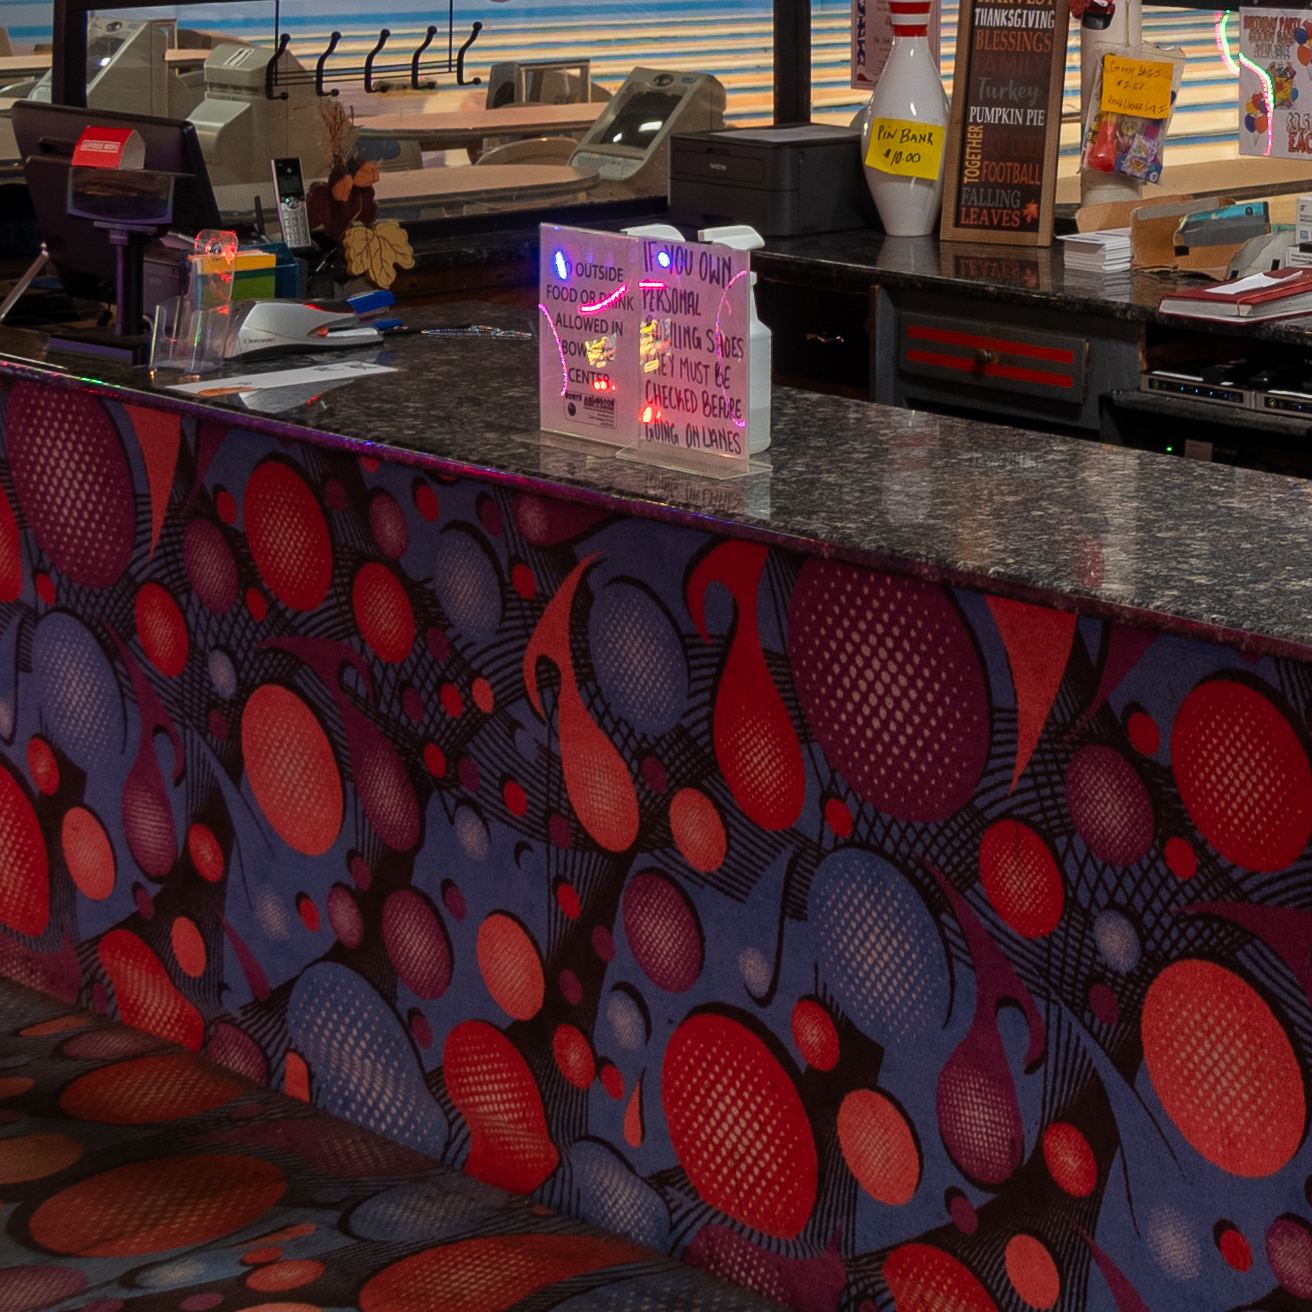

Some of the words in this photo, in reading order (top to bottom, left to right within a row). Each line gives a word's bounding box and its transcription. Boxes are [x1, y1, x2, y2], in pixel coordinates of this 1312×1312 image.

[975, 8, 1054, 29] THANKSGIVING
[976, 30, 1051, 52] BLESSINGS
[978, 77, 1039, 107] Turkey
[969, 106, 1024, 125] PUMPKIN
[1026, 109, 1045, 126] PIE
[883, 148, 921, 167] $10.00
[964, 125, 983, 183] TOGETHER
[982, 161, 1040, 185] FOOTBALL
[961, 187, 1021, 208] FALLING
[960, 207, 1020, 227] LEAVES
[576, 262, 624, 282] OUTSIDE
[546, 285, 577, 303] FOOD
[580, 290, 595, 303] OR
[643, 288, 701, 316] PERSONAL
[555, 313, 608, 333] ALLOWED
[611, 324, 623, 336] IN
[646, 380, 698, 414] CHECKED
[702, 392, 742, 420] BEFORE
[645, 420, 679, 445] GOING
[686, 424, 699, 448] ON
[702, 426, 742, 454] LANES
